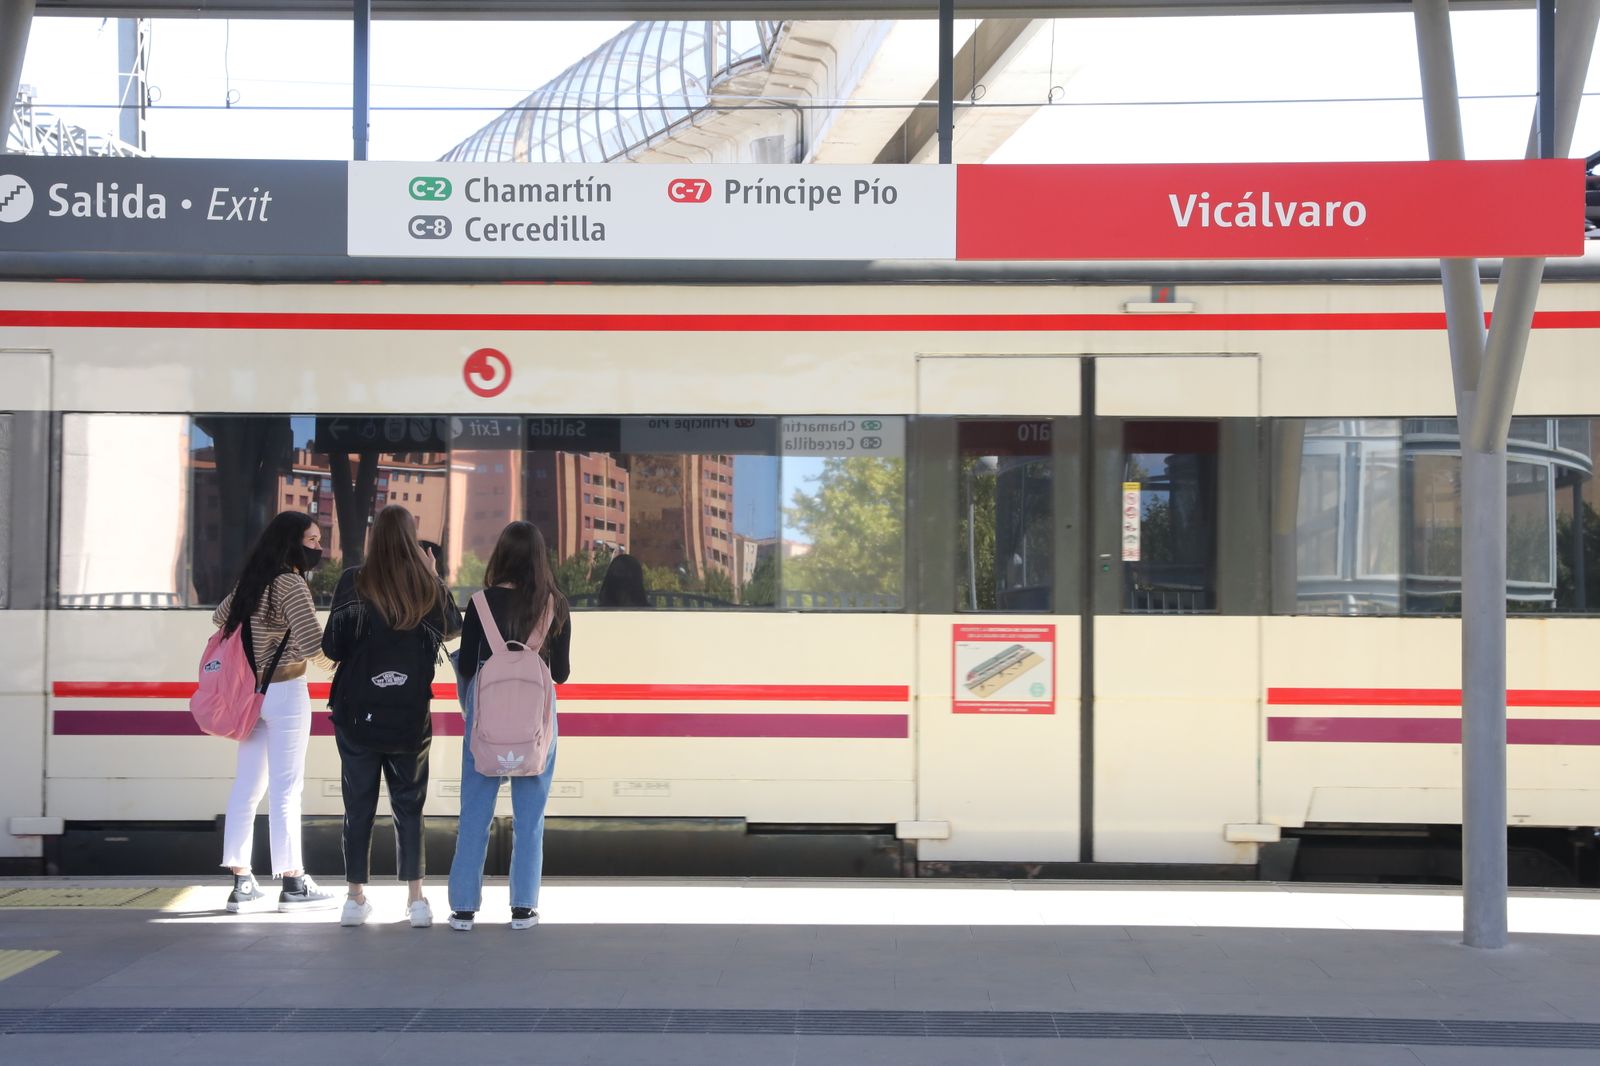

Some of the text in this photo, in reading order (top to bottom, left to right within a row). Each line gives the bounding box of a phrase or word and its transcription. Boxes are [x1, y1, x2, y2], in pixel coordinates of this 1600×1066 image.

[48, 182, 272, 222] Salida Exit
[412, 175, 612, 203] C-2 Chamartín
[671, 177, 898, 211] C-7 Príncipe Pío
[1168, 191, 1367, 228] Vicálvaro
[411, 215, 606, 242] C-8 Cercedilla
